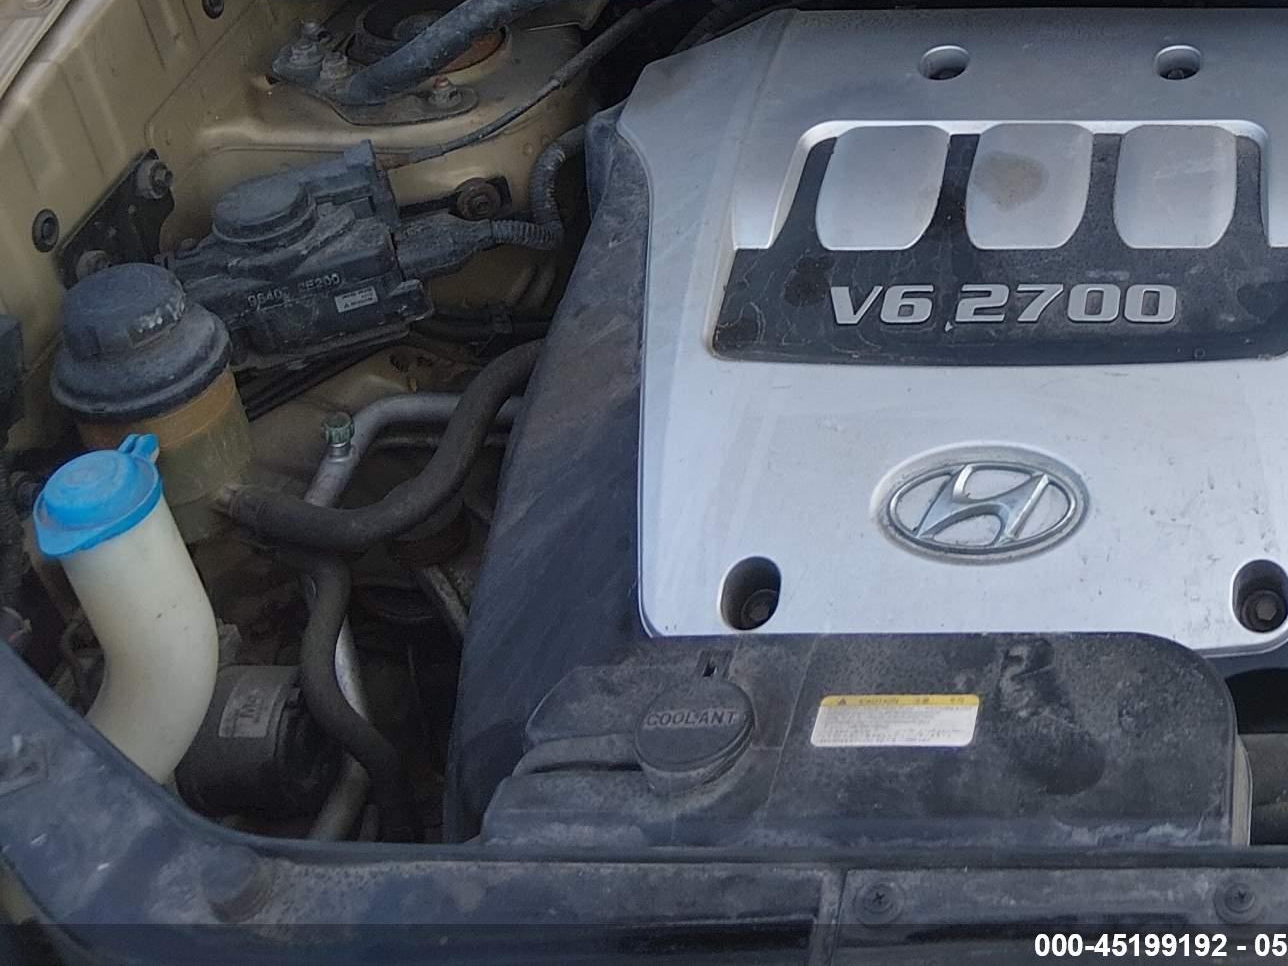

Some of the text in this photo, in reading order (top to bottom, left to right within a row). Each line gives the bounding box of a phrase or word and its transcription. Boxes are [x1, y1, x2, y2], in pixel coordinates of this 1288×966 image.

[830, 284, 1178, 325] V6 2700
[645, 709, 738, 726] COOLANT
